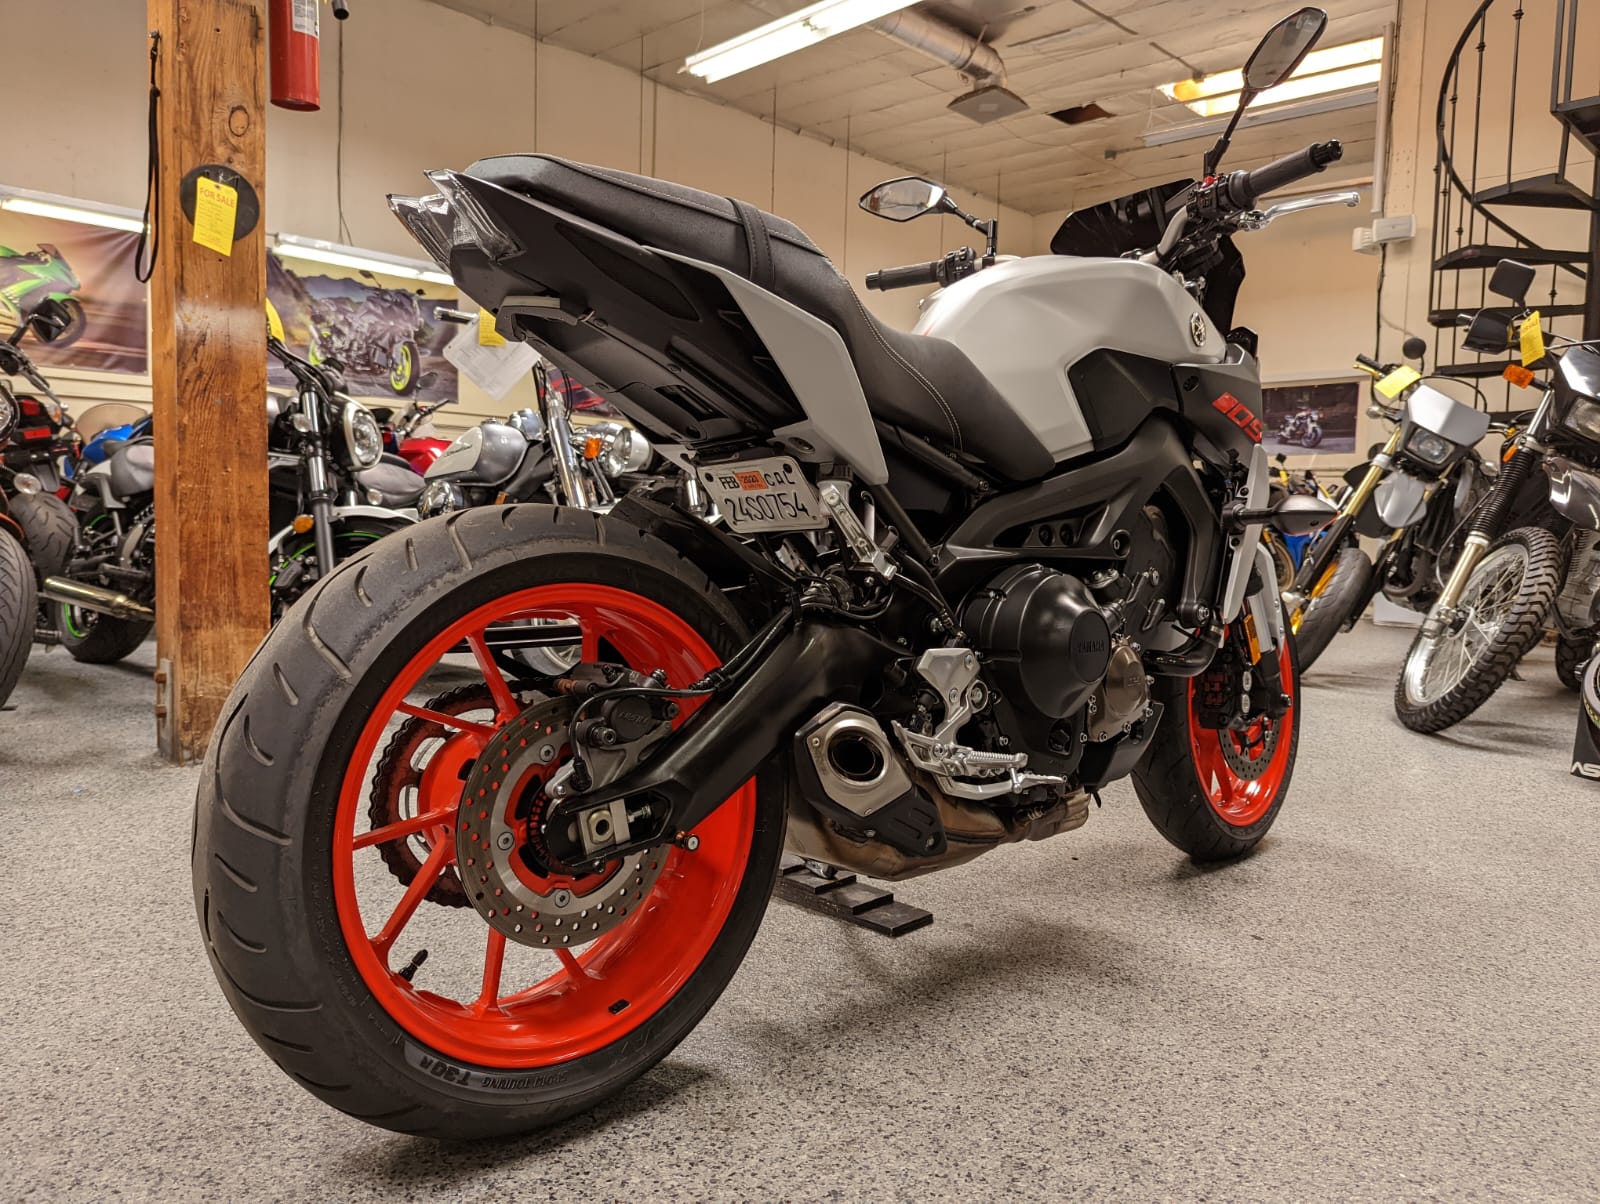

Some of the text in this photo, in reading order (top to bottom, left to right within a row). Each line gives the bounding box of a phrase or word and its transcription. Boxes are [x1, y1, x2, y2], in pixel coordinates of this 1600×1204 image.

[200, 187, 236, 208] FOR SALE
[719, 476, 739, 490] FEB
[764, 471, 796, 487] CAL
[724, 492, 810, 522] 24S0754
